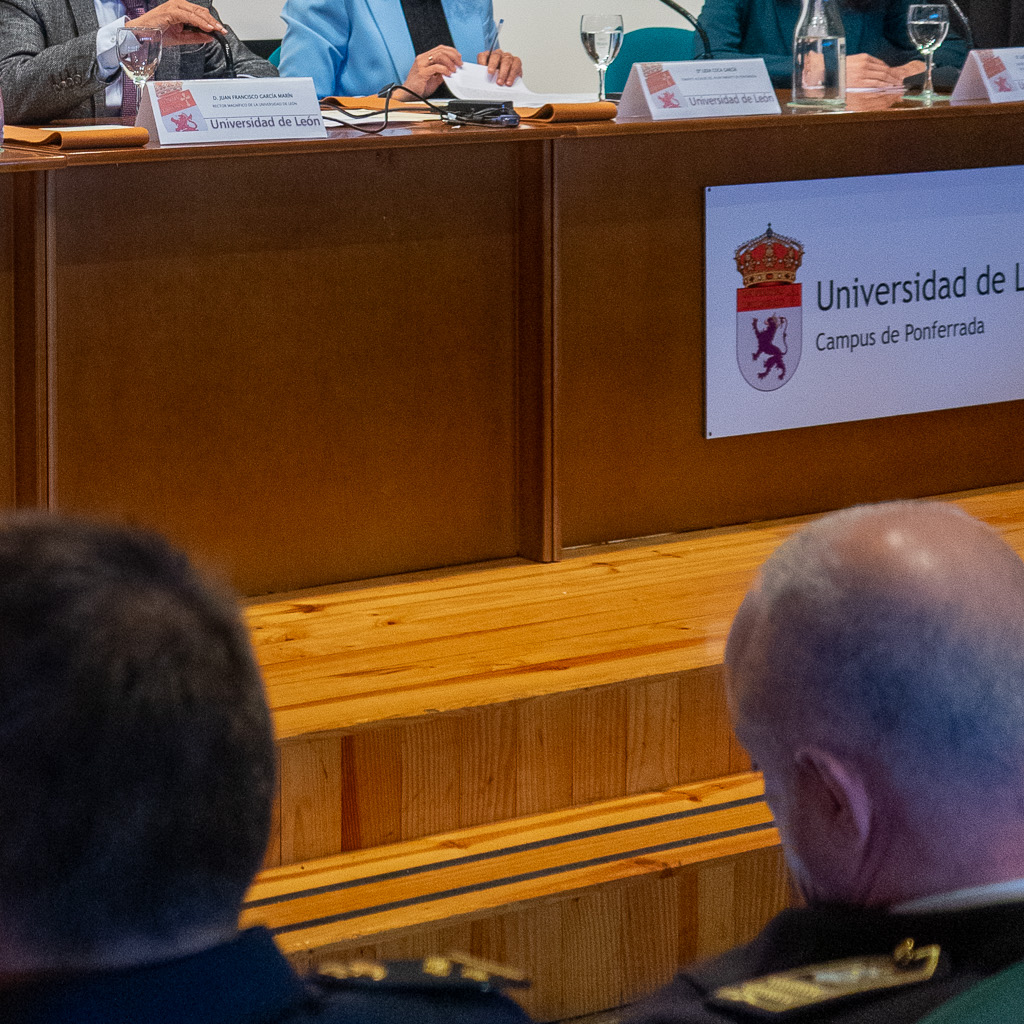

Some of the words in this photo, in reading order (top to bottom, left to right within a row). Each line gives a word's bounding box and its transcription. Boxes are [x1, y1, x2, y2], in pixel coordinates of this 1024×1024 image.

[689, 94, 740, 106] Universidad
[741, 94, 752, 103] de
[753, 92, 774, 103] León
[210, 118, 275, 129] Universidad
[278, 117, 292, 127] de
[294, 115, 321, 126] León
[816, 266, 967, 311] Universidad
[976, 265, 1006, 295] de
[816, 330, 876, 352] Campus
[881, 326, 899, 344] de
[905, 317, 985, 342] Ponferrada
